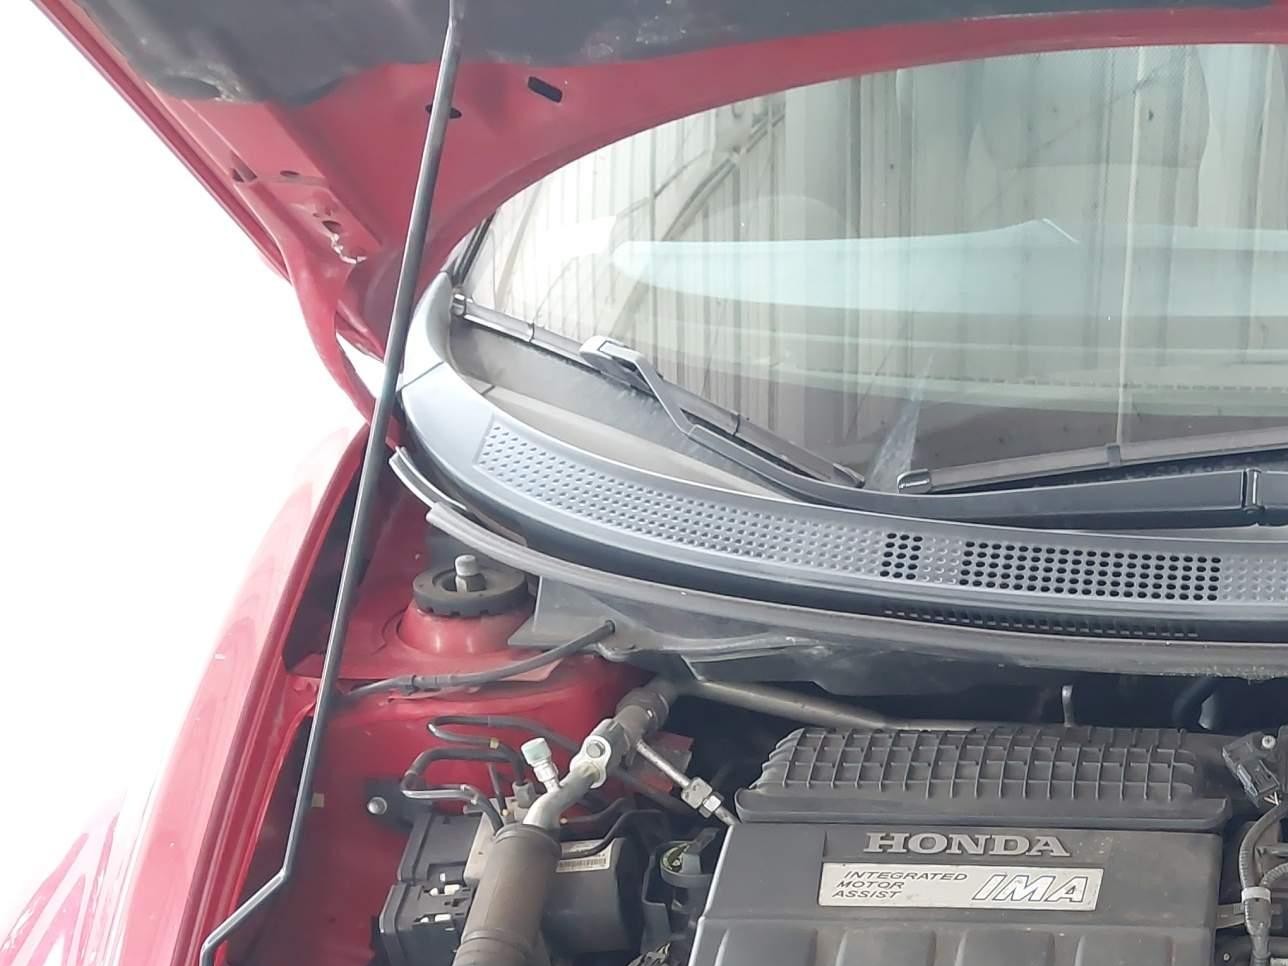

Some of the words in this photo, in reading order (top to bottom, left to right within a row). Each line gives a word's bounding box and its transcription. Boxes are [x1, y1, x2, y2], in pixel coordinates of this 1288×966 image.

[863, 832, 1071, 857] HONDA
[843, 870, 967, 881] INTEGRATED
[836, 880, 904, 889] MOTOR
[971, 873, 1089, 903] IMA
[832, 890, 903, 899] ASSIST
